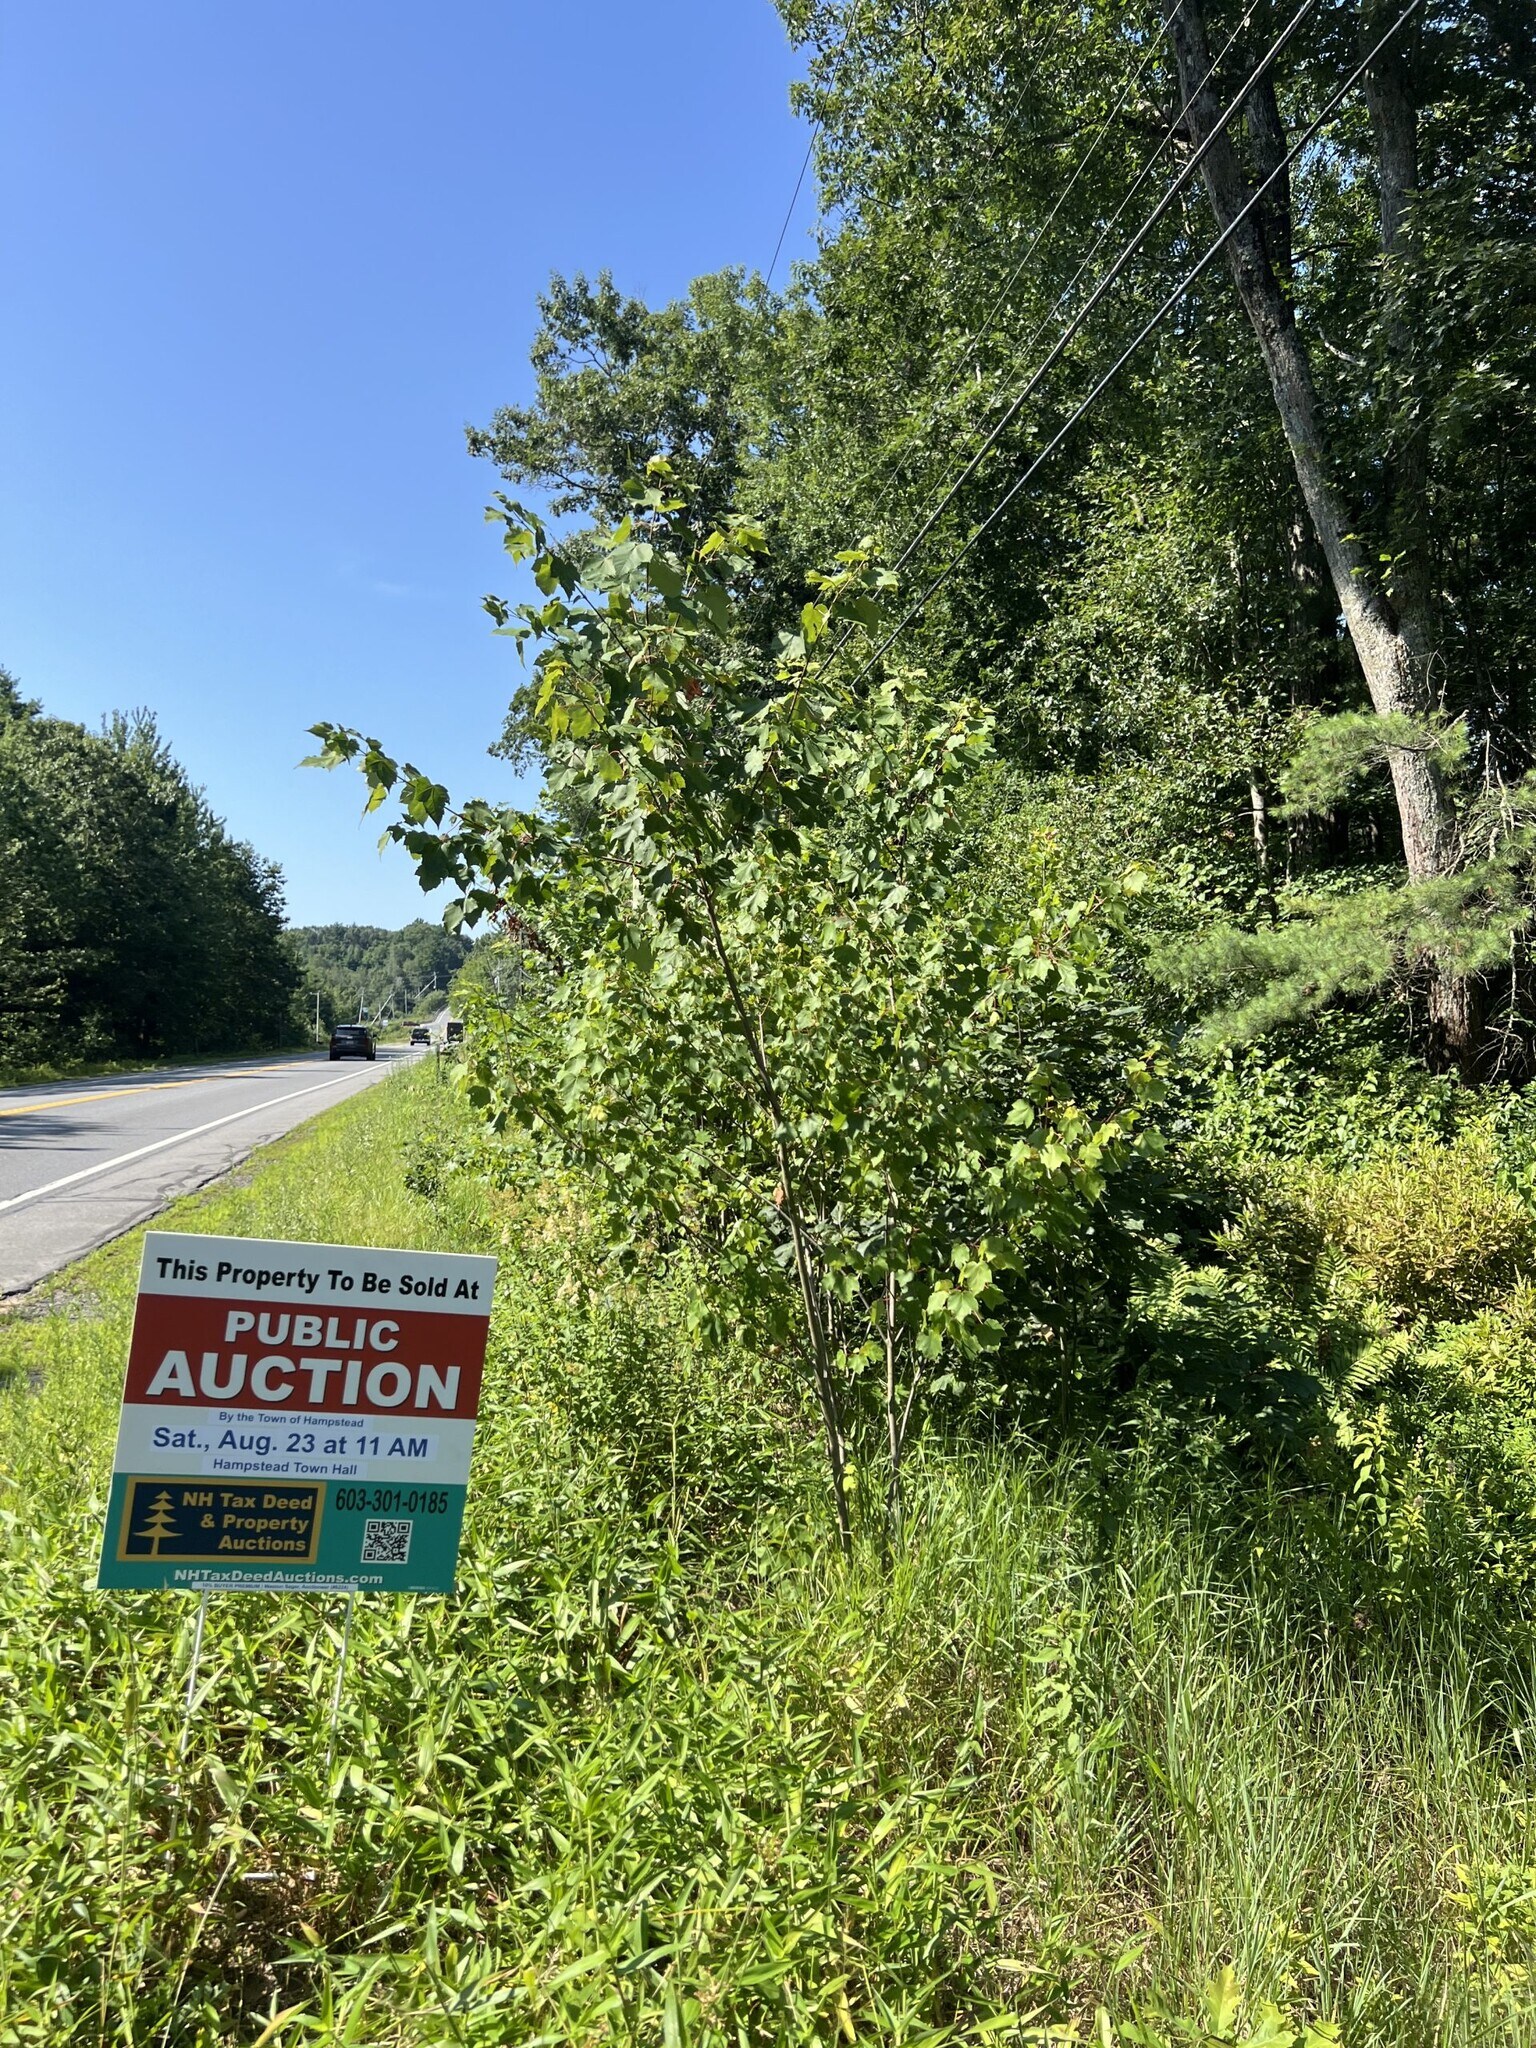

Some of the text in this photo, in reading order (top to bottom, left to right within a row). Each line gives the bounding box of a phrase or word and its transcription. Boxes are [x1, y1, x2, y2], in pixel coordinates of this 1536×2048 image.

[157, 1257, 479, 1300] This Property To Be Sold At
[224, 1310, 400, 1351] PUBLIC
[145, 1350, 461, 1410] AUCTION
[219, 1411, 364, 1428] By the Town of Hampstead
[153, 1427, 428, 1457] Sat., Aug. 23 at 11 AM
[213, 1458, 357, 1475] Hampstead Town Hall
[182, 1491, 313, 1510] NH Tax Deed
[335, 1488, 448, 1514] 603-301-0185
[200, 1513, 309, 1534] & Property
[218, 1535, 306, 1551] Auctions
[174, 1569, 383, 1584] NHTaxDeedAuctions.com
